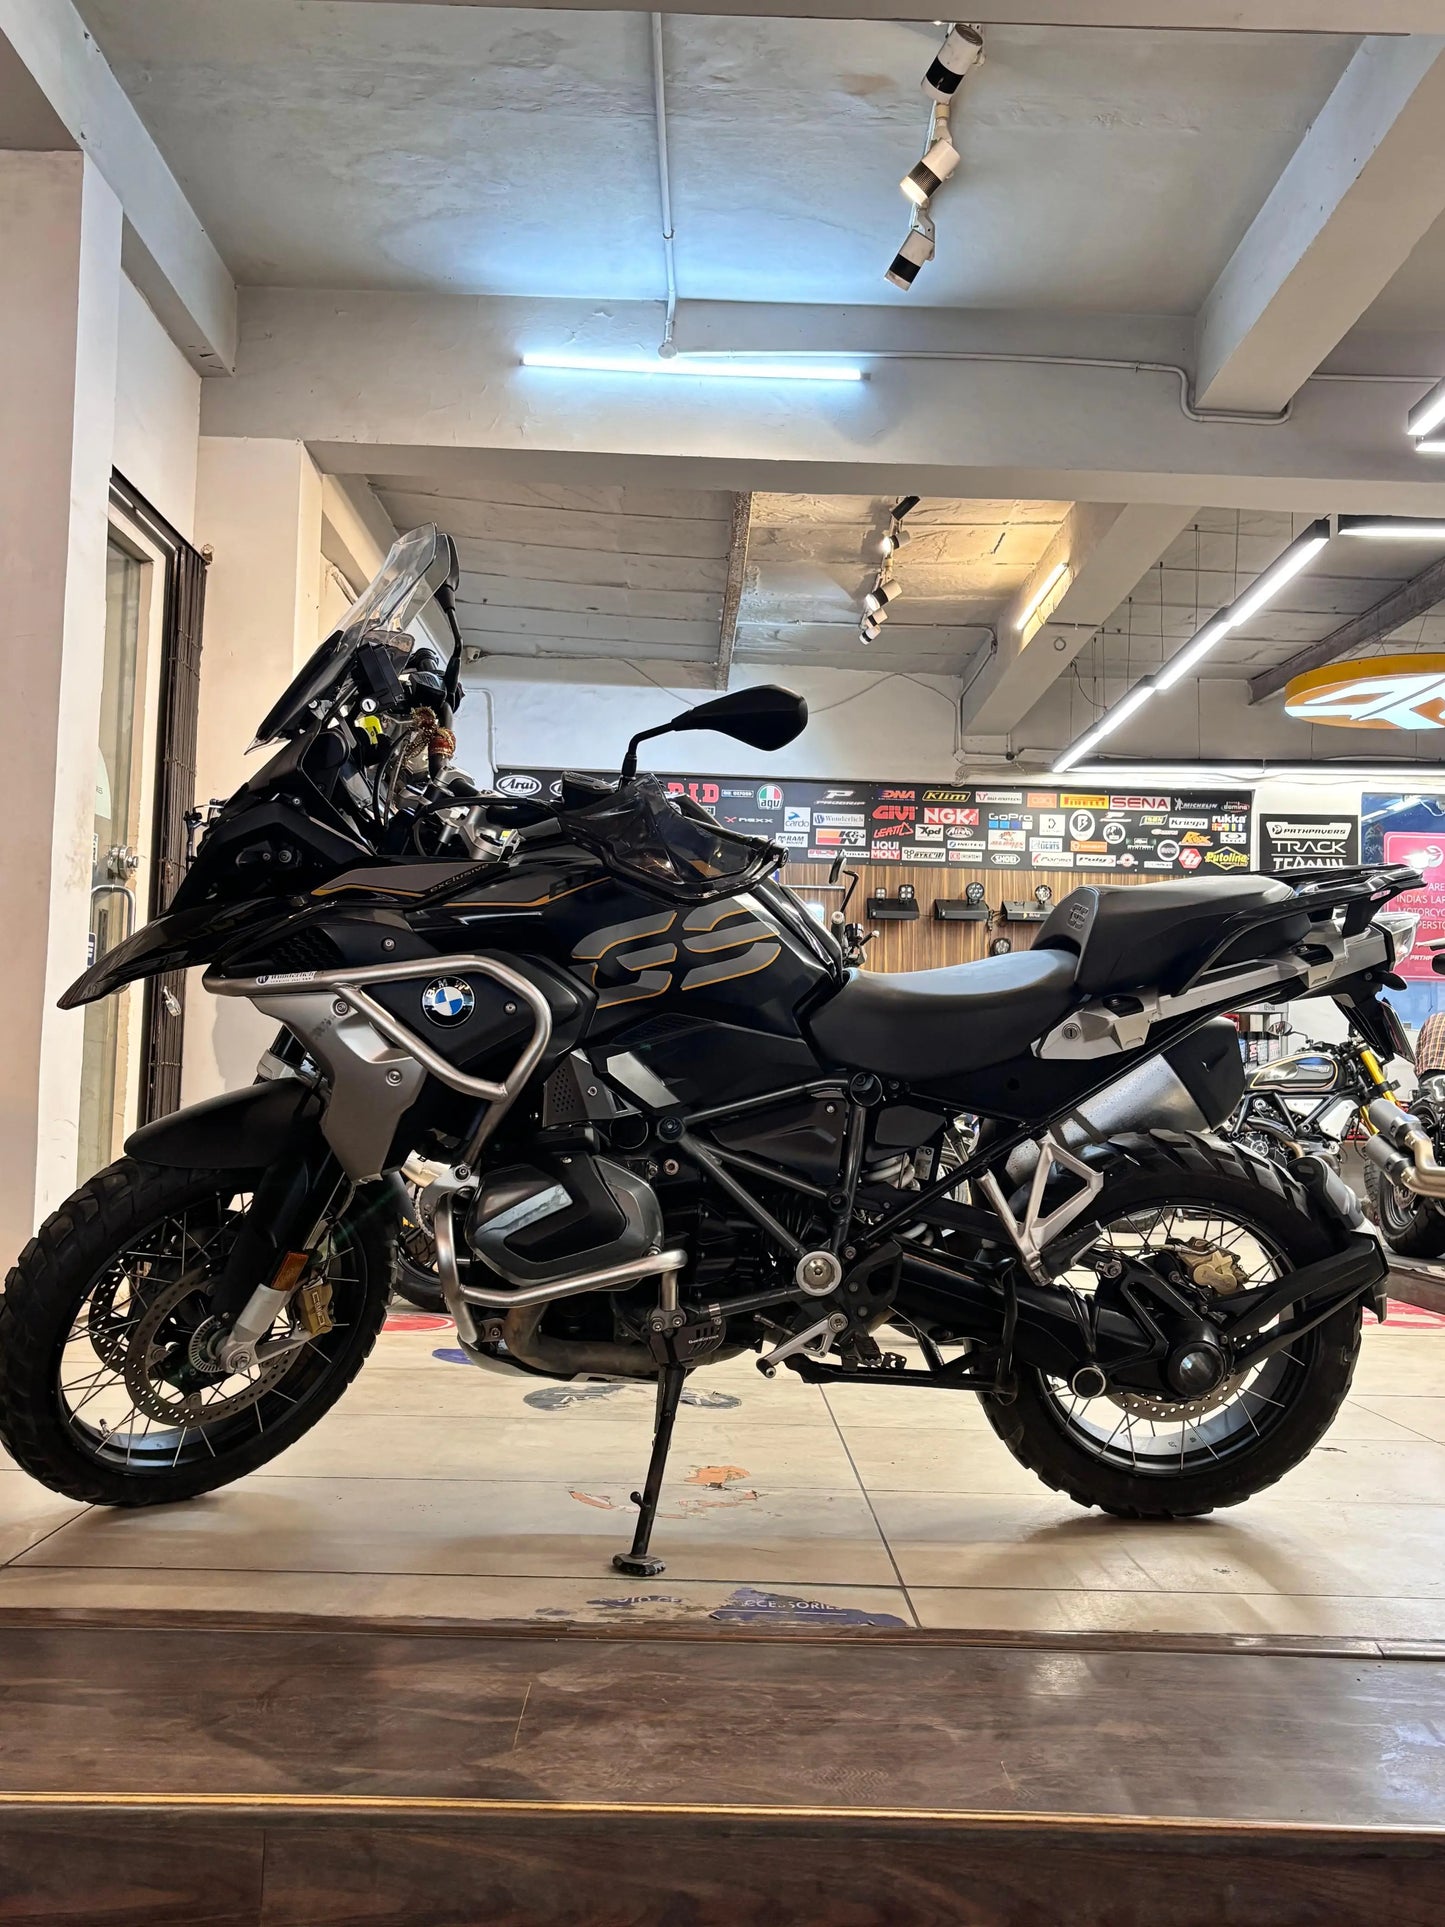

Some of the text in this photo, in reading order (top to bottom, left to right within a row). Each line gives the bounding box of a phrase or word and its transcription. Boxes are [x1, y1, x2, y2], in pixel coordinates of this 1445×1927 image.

[502, 778, 535, 790] Arai
[881, 790, 916, 799] DNA
[926, 792, 967, 801] Klim
[760, 800, 780, 810] agv
[1111, 797, 1169, 810] SENA
[872, 805, 916, 821] GIVI
[923, 807, 971, 825] NGK
[988, 812, 1033, 821] GoPro
[785, 820, 810, 828] cardo
[825, 815, 864, 823] Wunderlich
[1211, 814, 1246, 824] rukka
[871, 840, 900, 850] LIQUI
[1271, 840, 1347, 854] TRACK
[871, 850, 900, 860] MOLY
[430, 863, 489, 893] exclusive
[1396, 895, 1428, 904] INDIA'S
[425, 978, 471, 998] BMW
